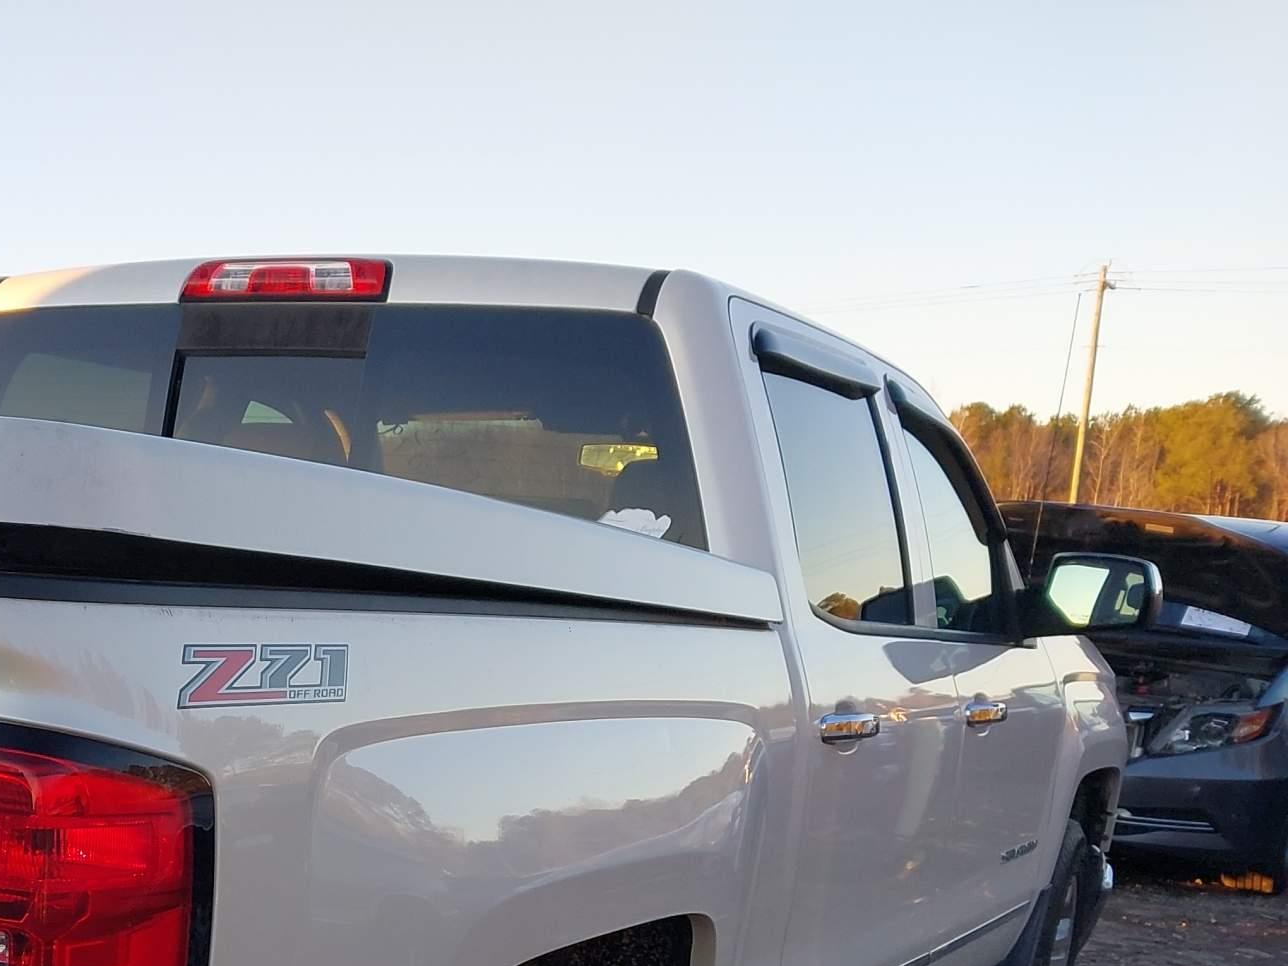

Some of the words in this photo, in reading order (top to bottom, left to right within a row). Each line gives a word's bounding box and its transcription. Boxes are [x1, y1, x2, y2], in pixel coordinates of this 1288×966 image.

[177, 644, 349, 710] Z71
[288, 689, 311, 700] OFF
[314, 687, 344, 699] ROAD
